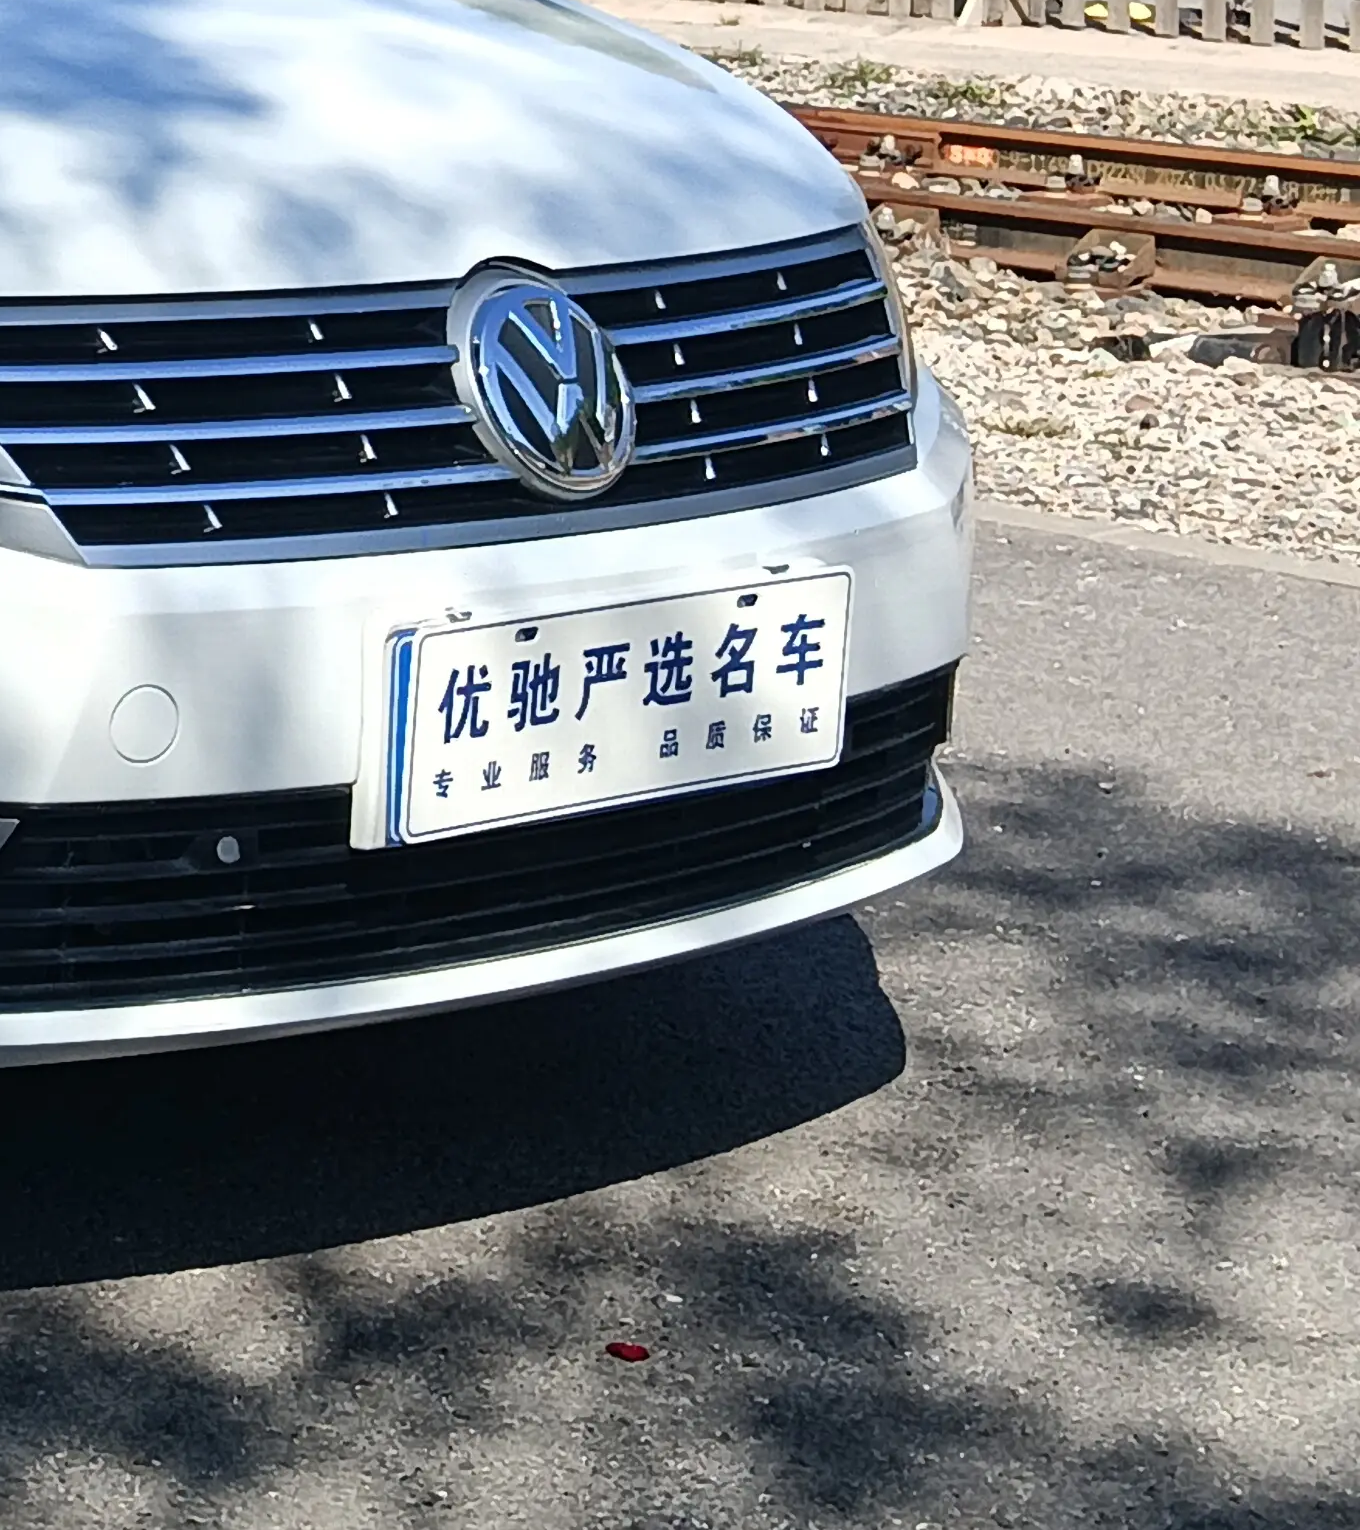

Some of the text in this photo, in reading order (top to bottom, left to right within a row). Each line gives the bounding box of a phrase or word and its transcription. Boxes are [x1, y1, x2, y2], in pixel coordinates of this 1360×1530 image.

[438, 614, 826, 744] 优驰严选名车
[433, 707, 819, 798] 专业服务 品质保证
